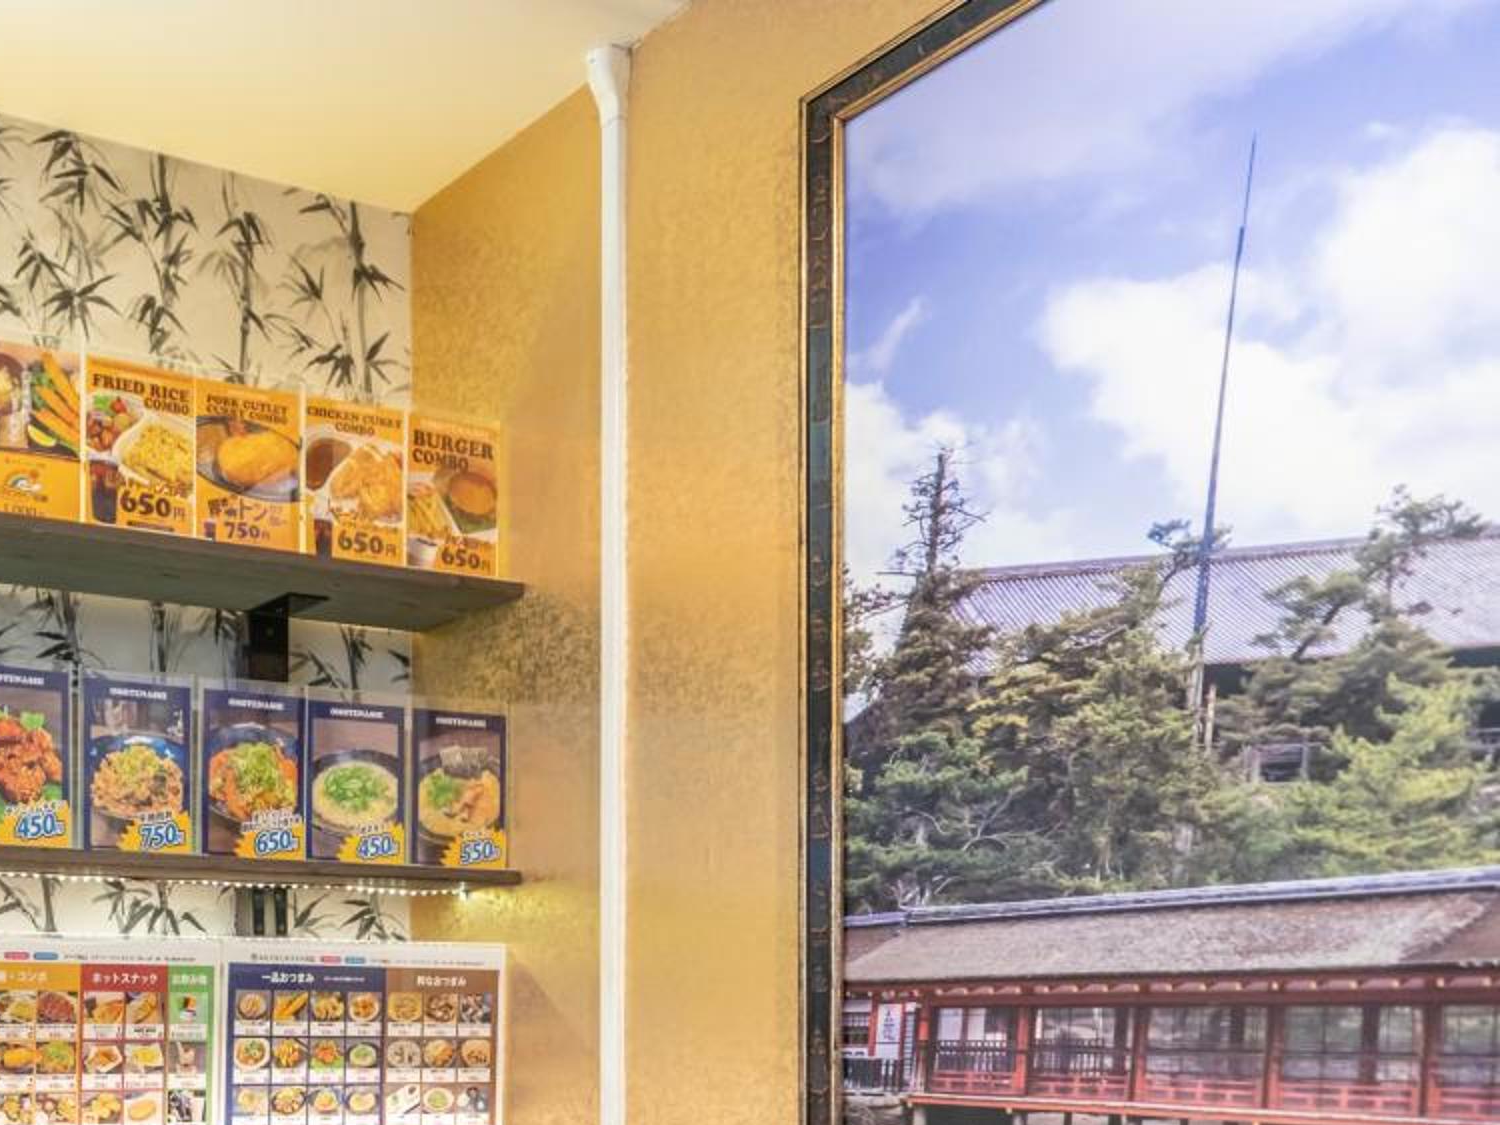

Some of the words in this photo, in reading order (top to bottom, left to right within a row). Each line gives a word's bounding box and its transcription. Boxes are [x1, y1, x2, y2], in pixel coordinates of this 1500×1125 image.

[92, 372, 146, 395] FRIED
[150, 383, 190, 402] RICE
[144, 397, 190, 416] COMBO
[307, 405, 360, 423] CHICKEN
[335, 421, 375, 437] COMBO
[413, 429, 494, 461] BURGER
[412, 448, 469, 472] COMBO
